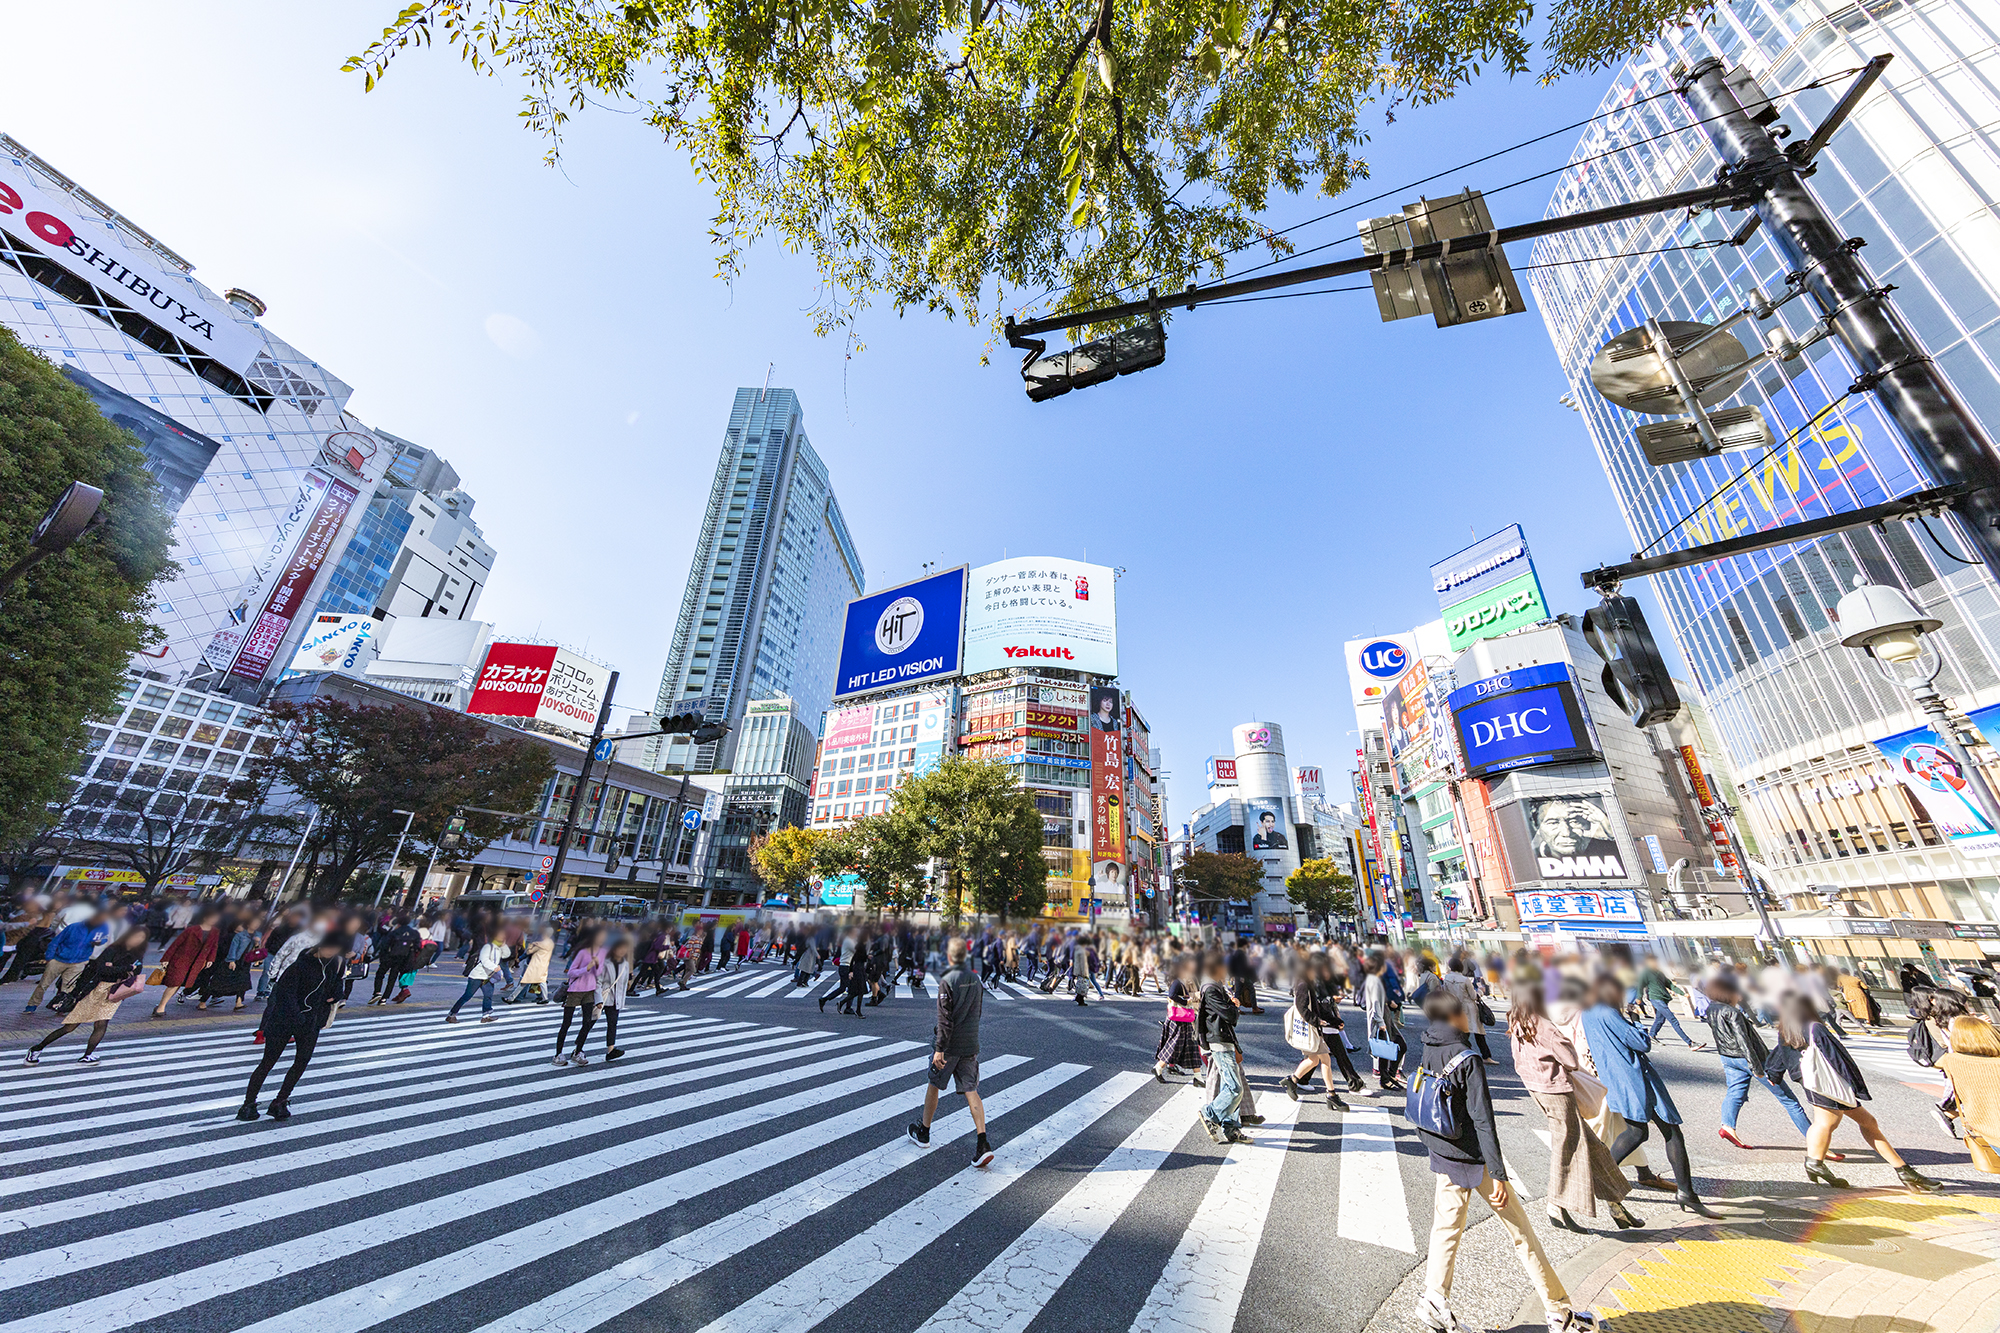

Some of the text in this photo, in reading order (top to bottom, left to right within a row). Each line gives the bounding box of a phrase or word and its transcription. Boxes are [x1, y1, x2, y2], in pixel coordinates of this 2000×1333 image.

[62, 236, 214, 341] SHIBUYA
[1684, 398, 1863, 562] NEWS
[985, 570, 1073, 587] ダンサー菅原小春は、
[1433, 546, 1524, 592] Hisamitsu
[984, 584, 1061, 600] 正解のない表現と
[984, 597, 1073, 612] 今日も格闘している。
[1447, 589, 1537, 636] サロンパス
[302, 621, 358, 652] SANKYO
[344, 621, 372, 668] SANKYO
[1003, 645, 1075, 661] Yakult
[1363, 648, 1404, 670] UC
[484, 663, 547, 682] カラオケ
[554, 660, 594, 686] ココロの
[848, 656, 943, 689] HIT LED VISION
[479, 680, 543, 694] JOYSOUND
[549, 673, 600, 703] ボリューム、
[1475, 675, 1513, 696] DHC
[545, 686, 597, 712] あげていこう。
[676, 699, 706, 712] 渋谷駅前
[540, 696, 595, 724] JOYSOUND
[1026, 711, 1076, 727] コンタクト
[994, 729, 1018, 741] ガスト
[1423, 687, 1450, 763] もんじゃ
[1470, 707, 1552, 748] DHC
[831, 733, 869, 746] 品川美容外科
[1061, 732, 1085, 743] ガスト
[1242, 728, 1272, 747] 109
[1046, 757, 1091, 768] 英会話イーオン
[1103, 734, 1120, 791] 竹島宏
[1218, 770, 1236, 778] QLO
[1297, 769, 1319, 784] H&M
[1683, 748, 1710, 802] クスリのことなら
[1537, 855, 1626, 878] DMM
[1521, 895, 1628, 915] 大盛堂書店
